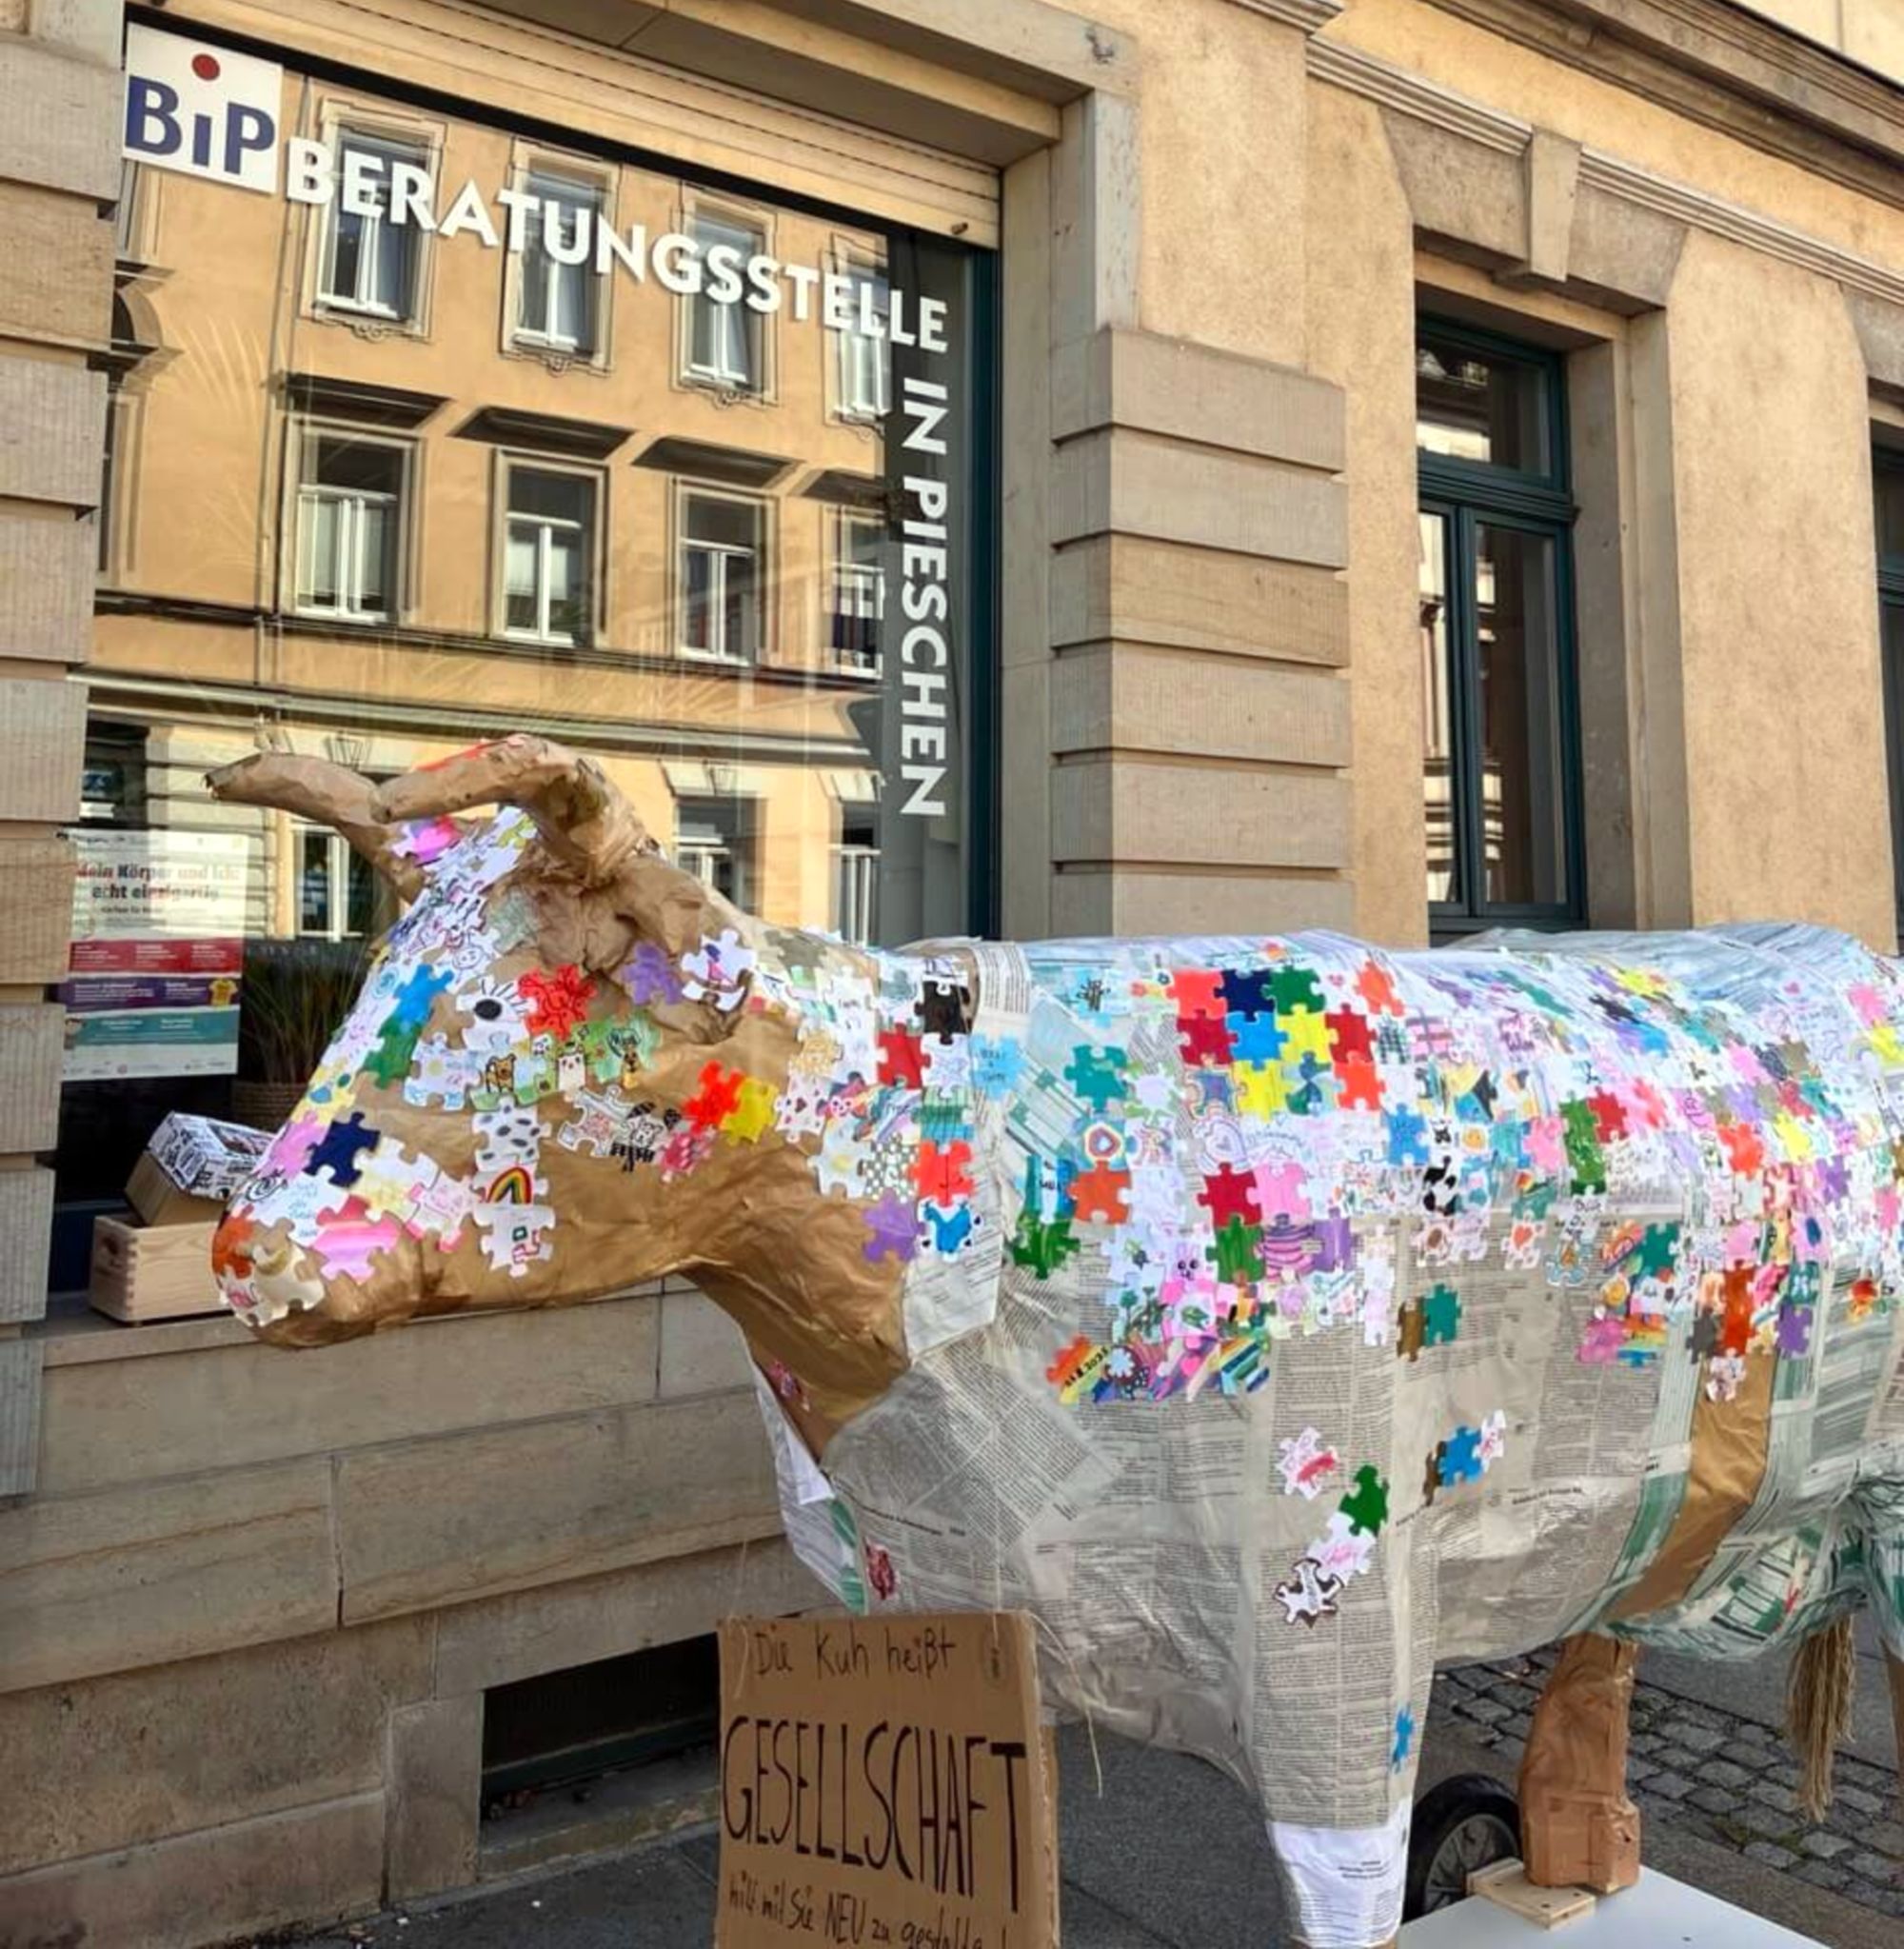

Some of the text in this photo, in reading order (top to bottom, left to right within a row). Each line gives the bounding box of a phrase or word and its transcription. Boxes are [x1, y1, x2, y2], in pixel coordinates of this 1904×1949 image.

[125, 53, 275, 175] BiP
[286, 138, 948, 354] BERATUNGSSTELLE
[900, 377, 948, 816] IN PIESCHEN
[755, 1621, 956, 1680] Die Kuh heißt
[723, 1715, 1027, 1914] GESELLSCHAFT
[824, 1892, 867, 1945] NEU
[872, 1918, 890, 1944] zu
